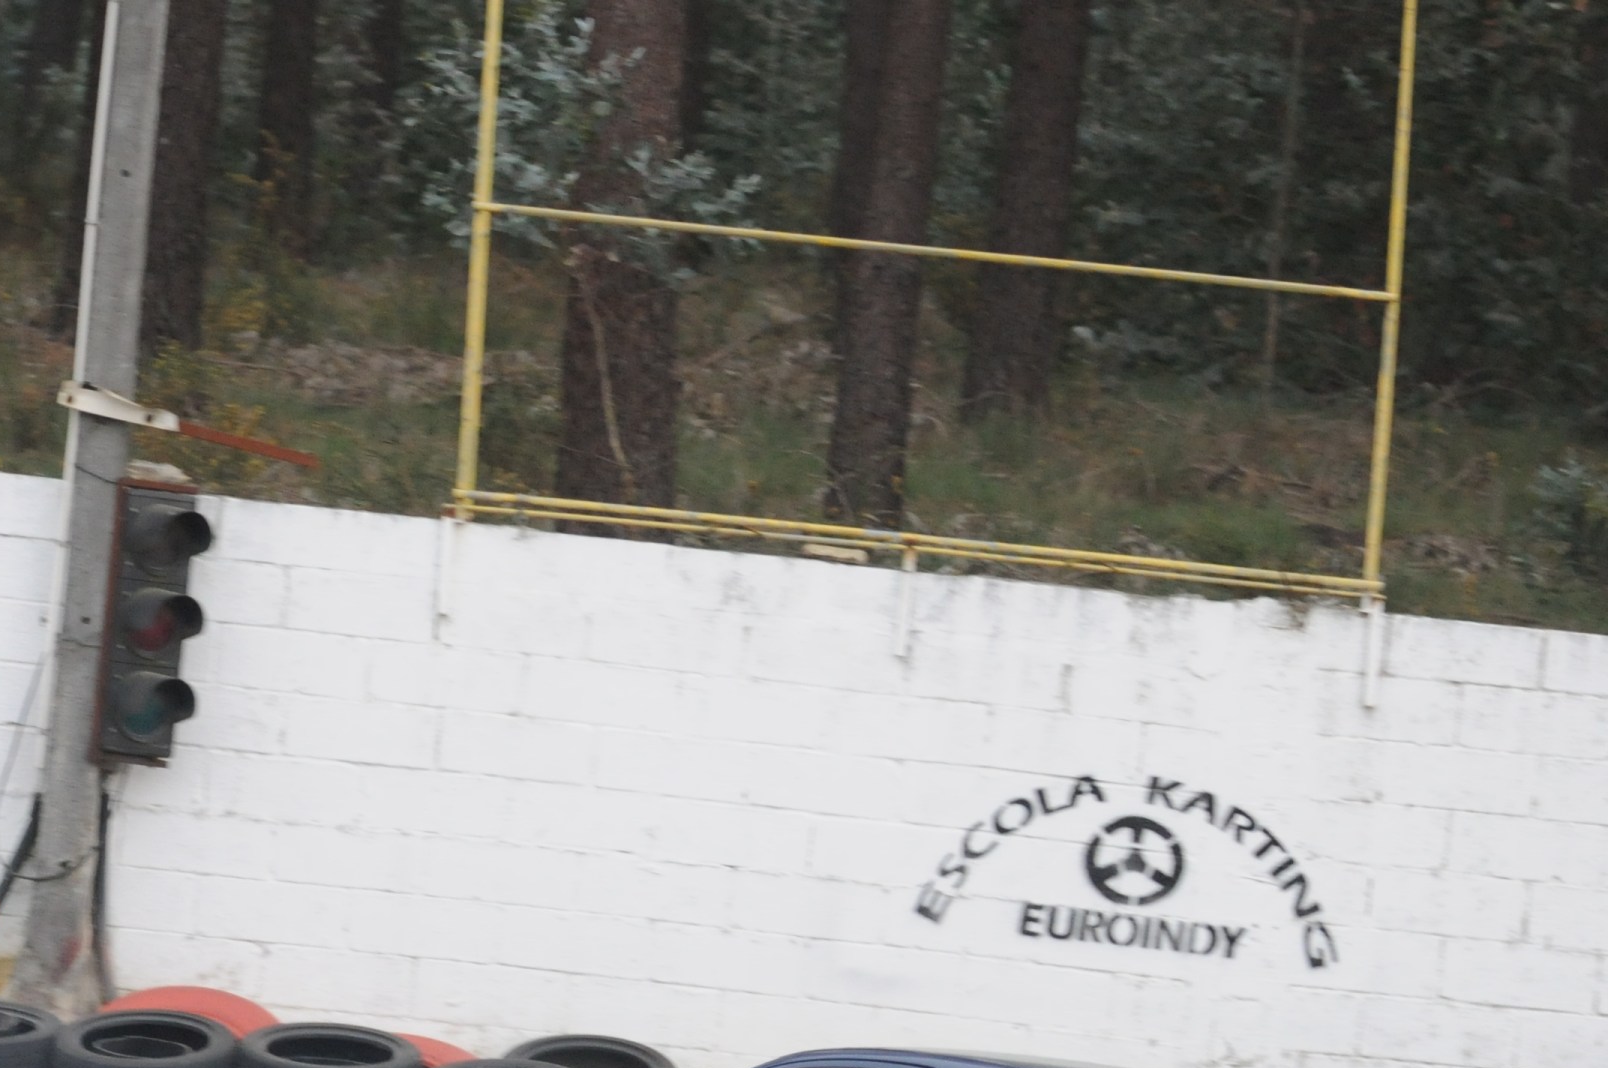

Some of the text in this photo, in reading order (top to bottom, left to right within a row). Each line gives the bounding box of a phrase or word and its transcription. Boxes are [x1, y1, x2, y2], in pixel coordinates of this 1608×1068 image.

[913, 775, 1340, 969] ESCOLA KARTING
[1018, 902, 1247, 959] EUROINDY
